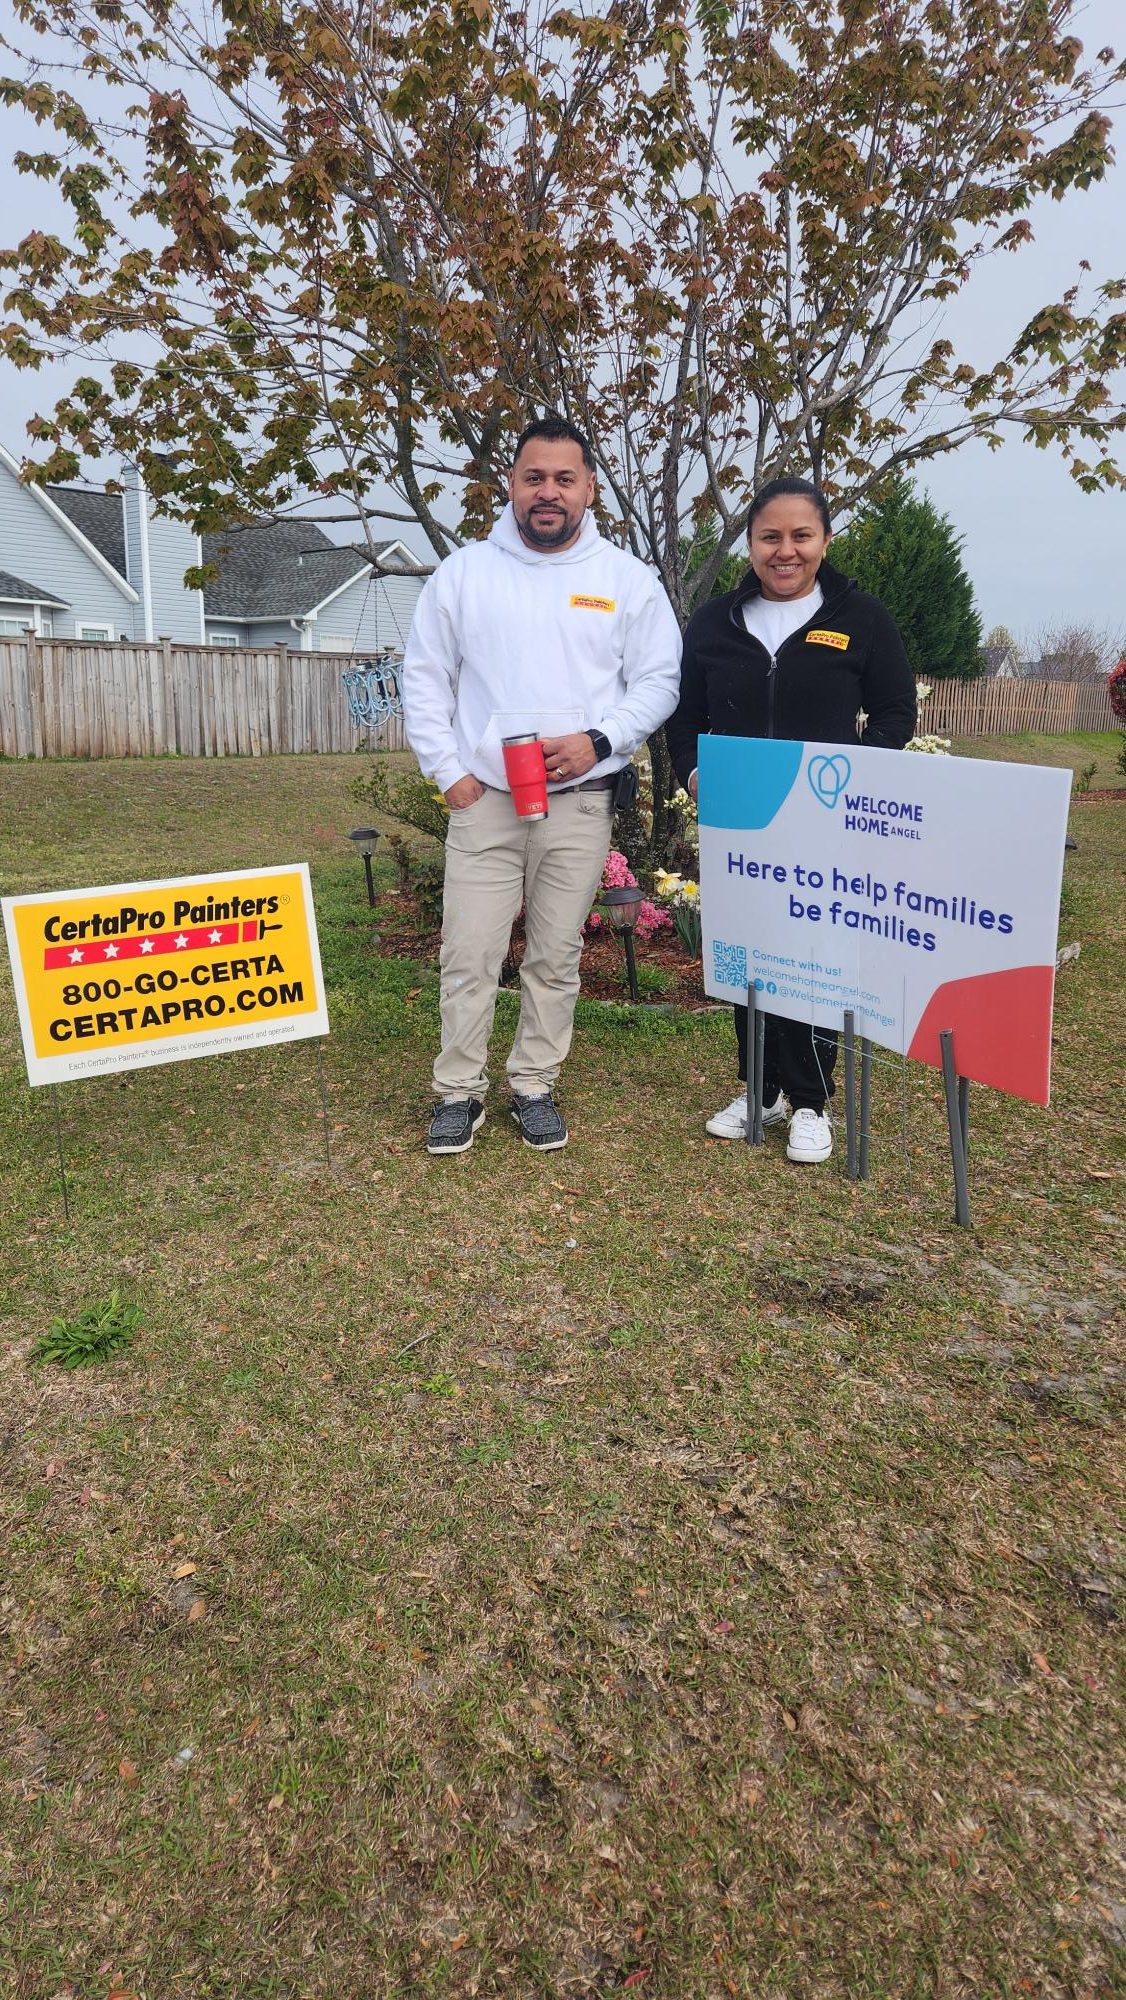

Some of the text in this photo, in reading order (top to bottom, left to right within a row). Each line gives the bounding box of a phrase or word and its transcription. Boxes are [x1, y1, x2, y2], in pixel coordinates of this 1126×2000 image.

[844, 794, 923, 822] WELCOME
[845, 814, 922, 840] HOME ANGEL
[728, 851, 1014, 934] Here to help families
[44, 907, 165, 943] CertaPro
[789, 894, 936, 952] be families
[62, 954, 285, 1006] 800-GO-CERTA
[752, 949, 842, 977] Connect with us!
[49, 981, 304, 1042] CERTAPRO.COM
[68, 1061, 86, 1071] Each
[87, 1056, 117, 1068] CertaPro
[150, 1046, 180, 1057] business
[188, 1036, 232, 1049] independently
[233, 1032, 254, 1042] owned
[255, 1029, 267, 1038] and
[268, 1025, 295, 1036] operated
